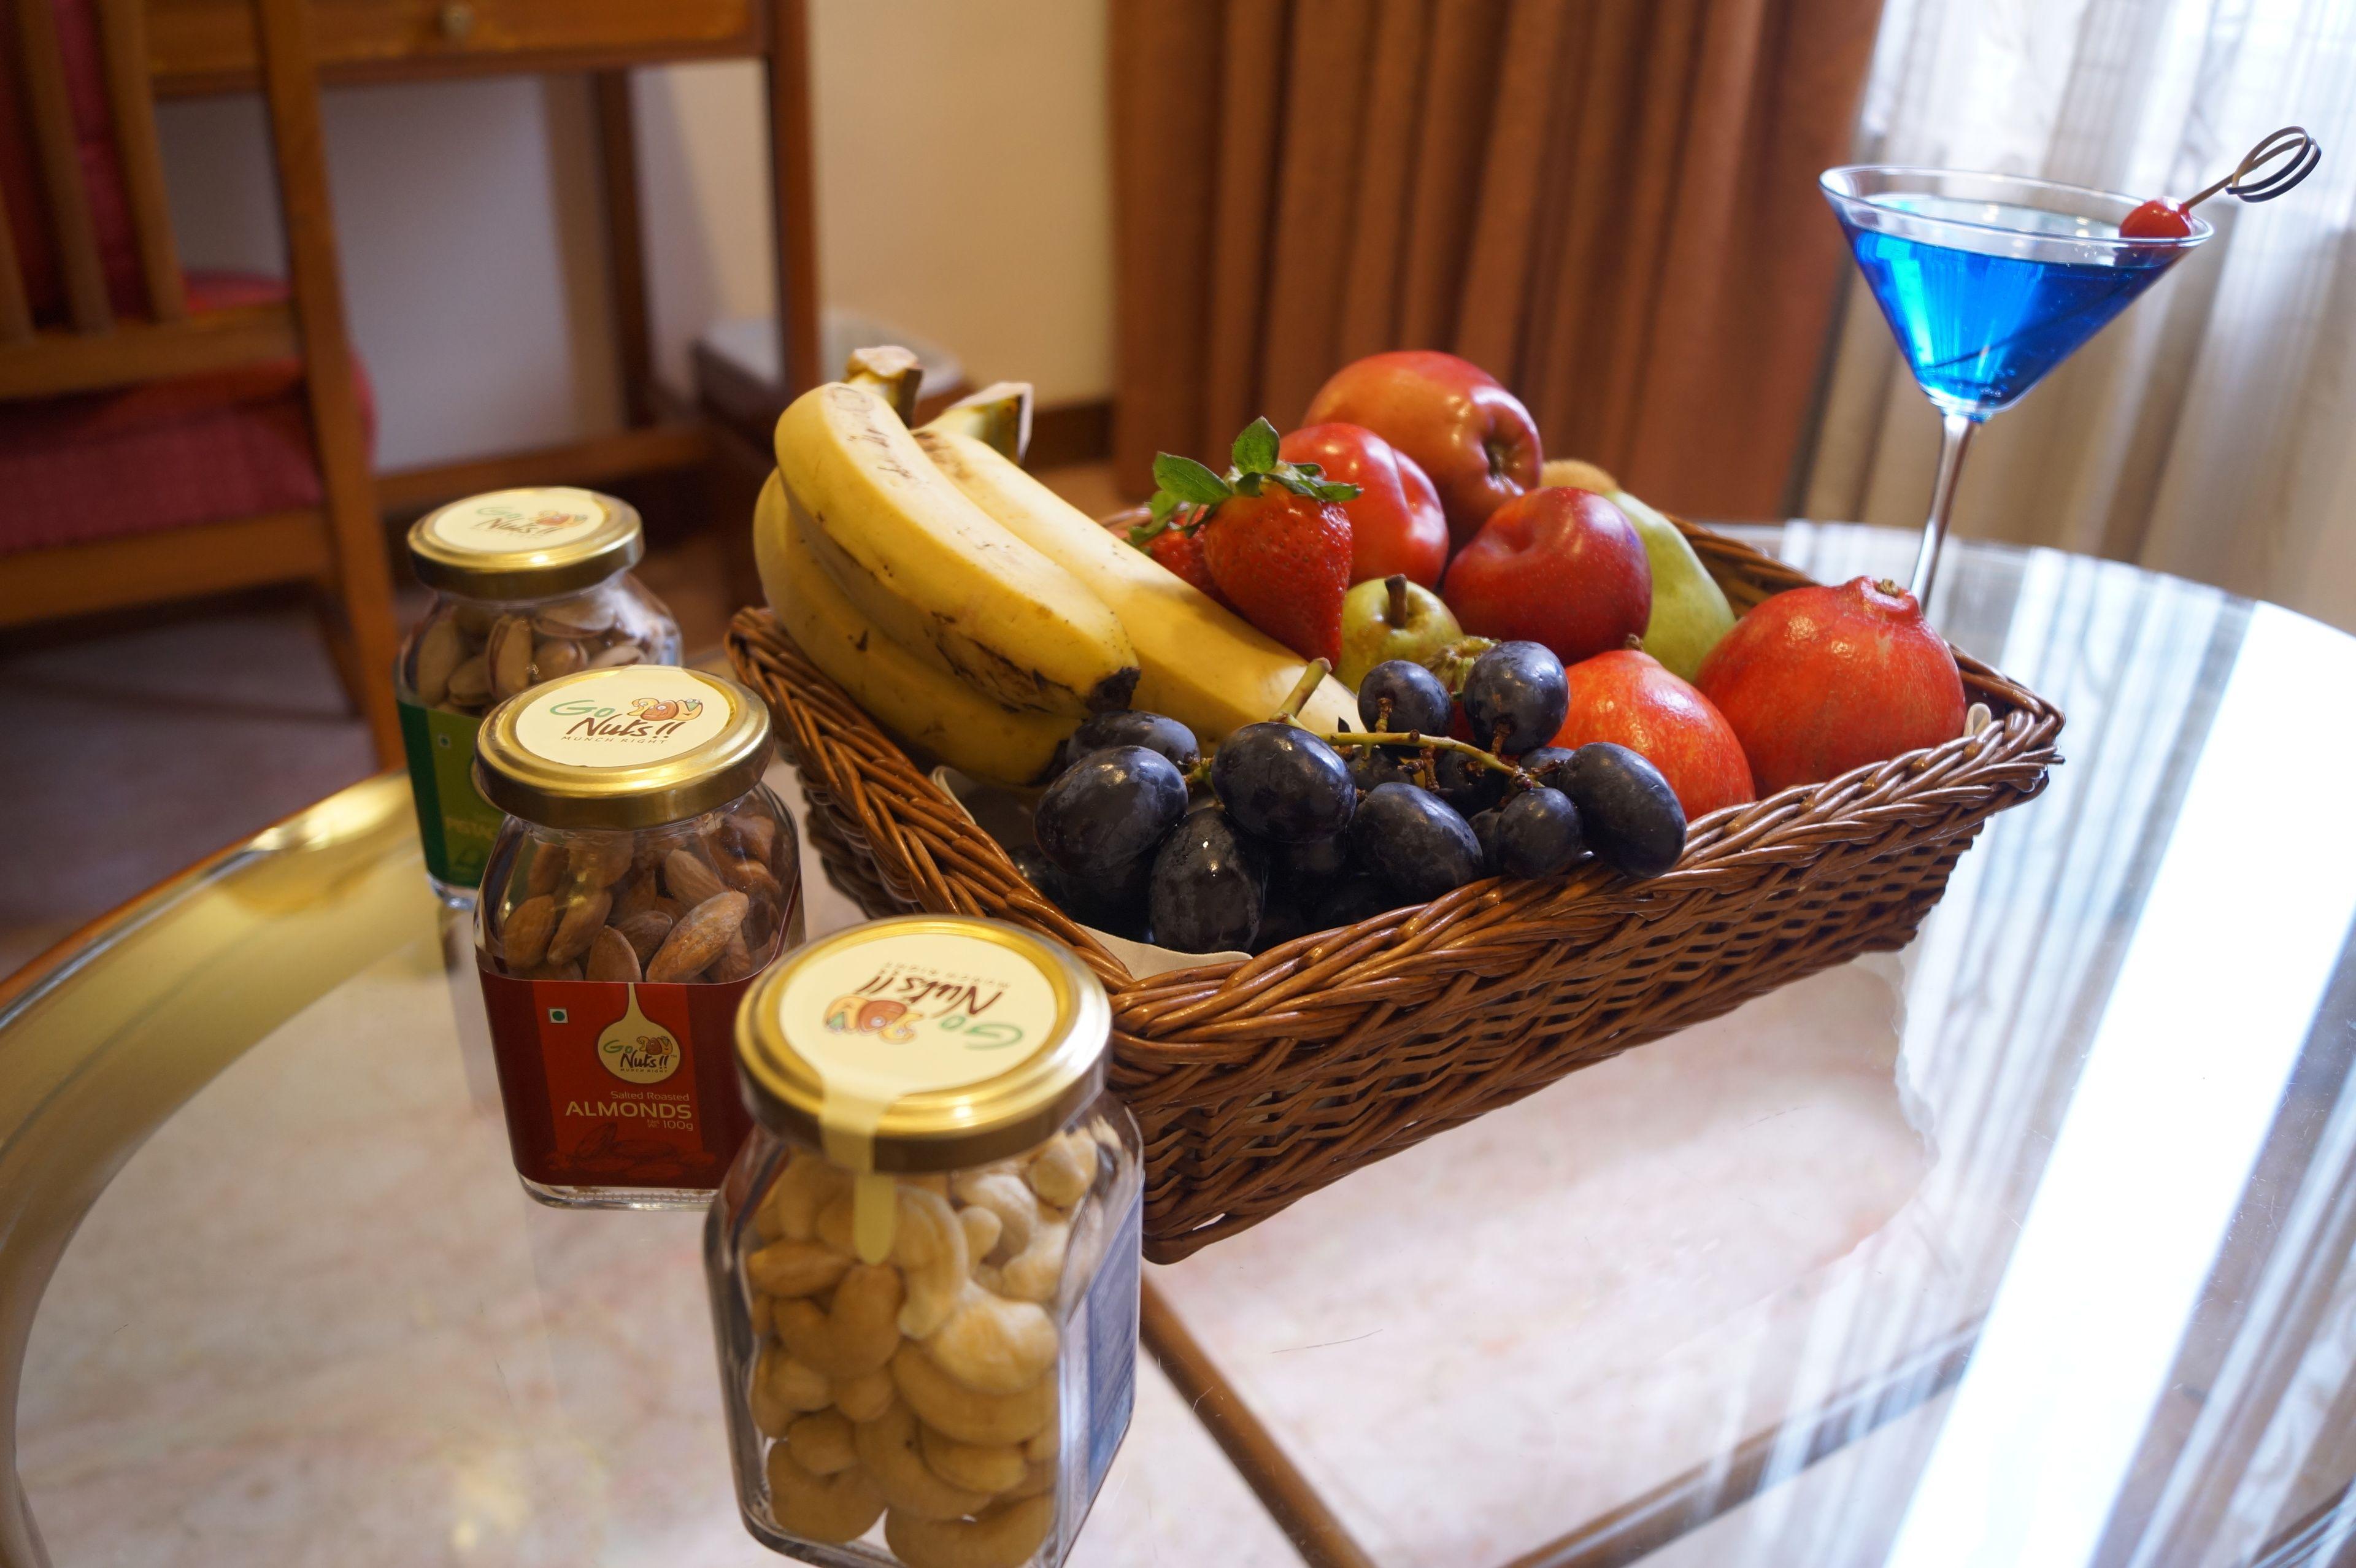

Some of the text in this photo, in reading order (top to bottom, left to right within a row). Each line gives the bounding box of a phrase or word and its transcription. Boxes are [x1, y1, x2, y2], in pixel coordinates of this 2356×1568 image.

[550, 699, 615, 718] Go
[566, 713, 686, 738] Nuts!!
[853, 968, 1003, 1019] Nuts!!
[939, 1015, 1023, 1050] Go
[603, 1040, 633, 1053] Go
[620, 1050, 670, 1069] Nuts!!
[610, 1091, 690, 1101] Salted Roasted
[565, 1101, 692, 1119] ALMONDS
[663, 1120, 693, 1131] 100g
